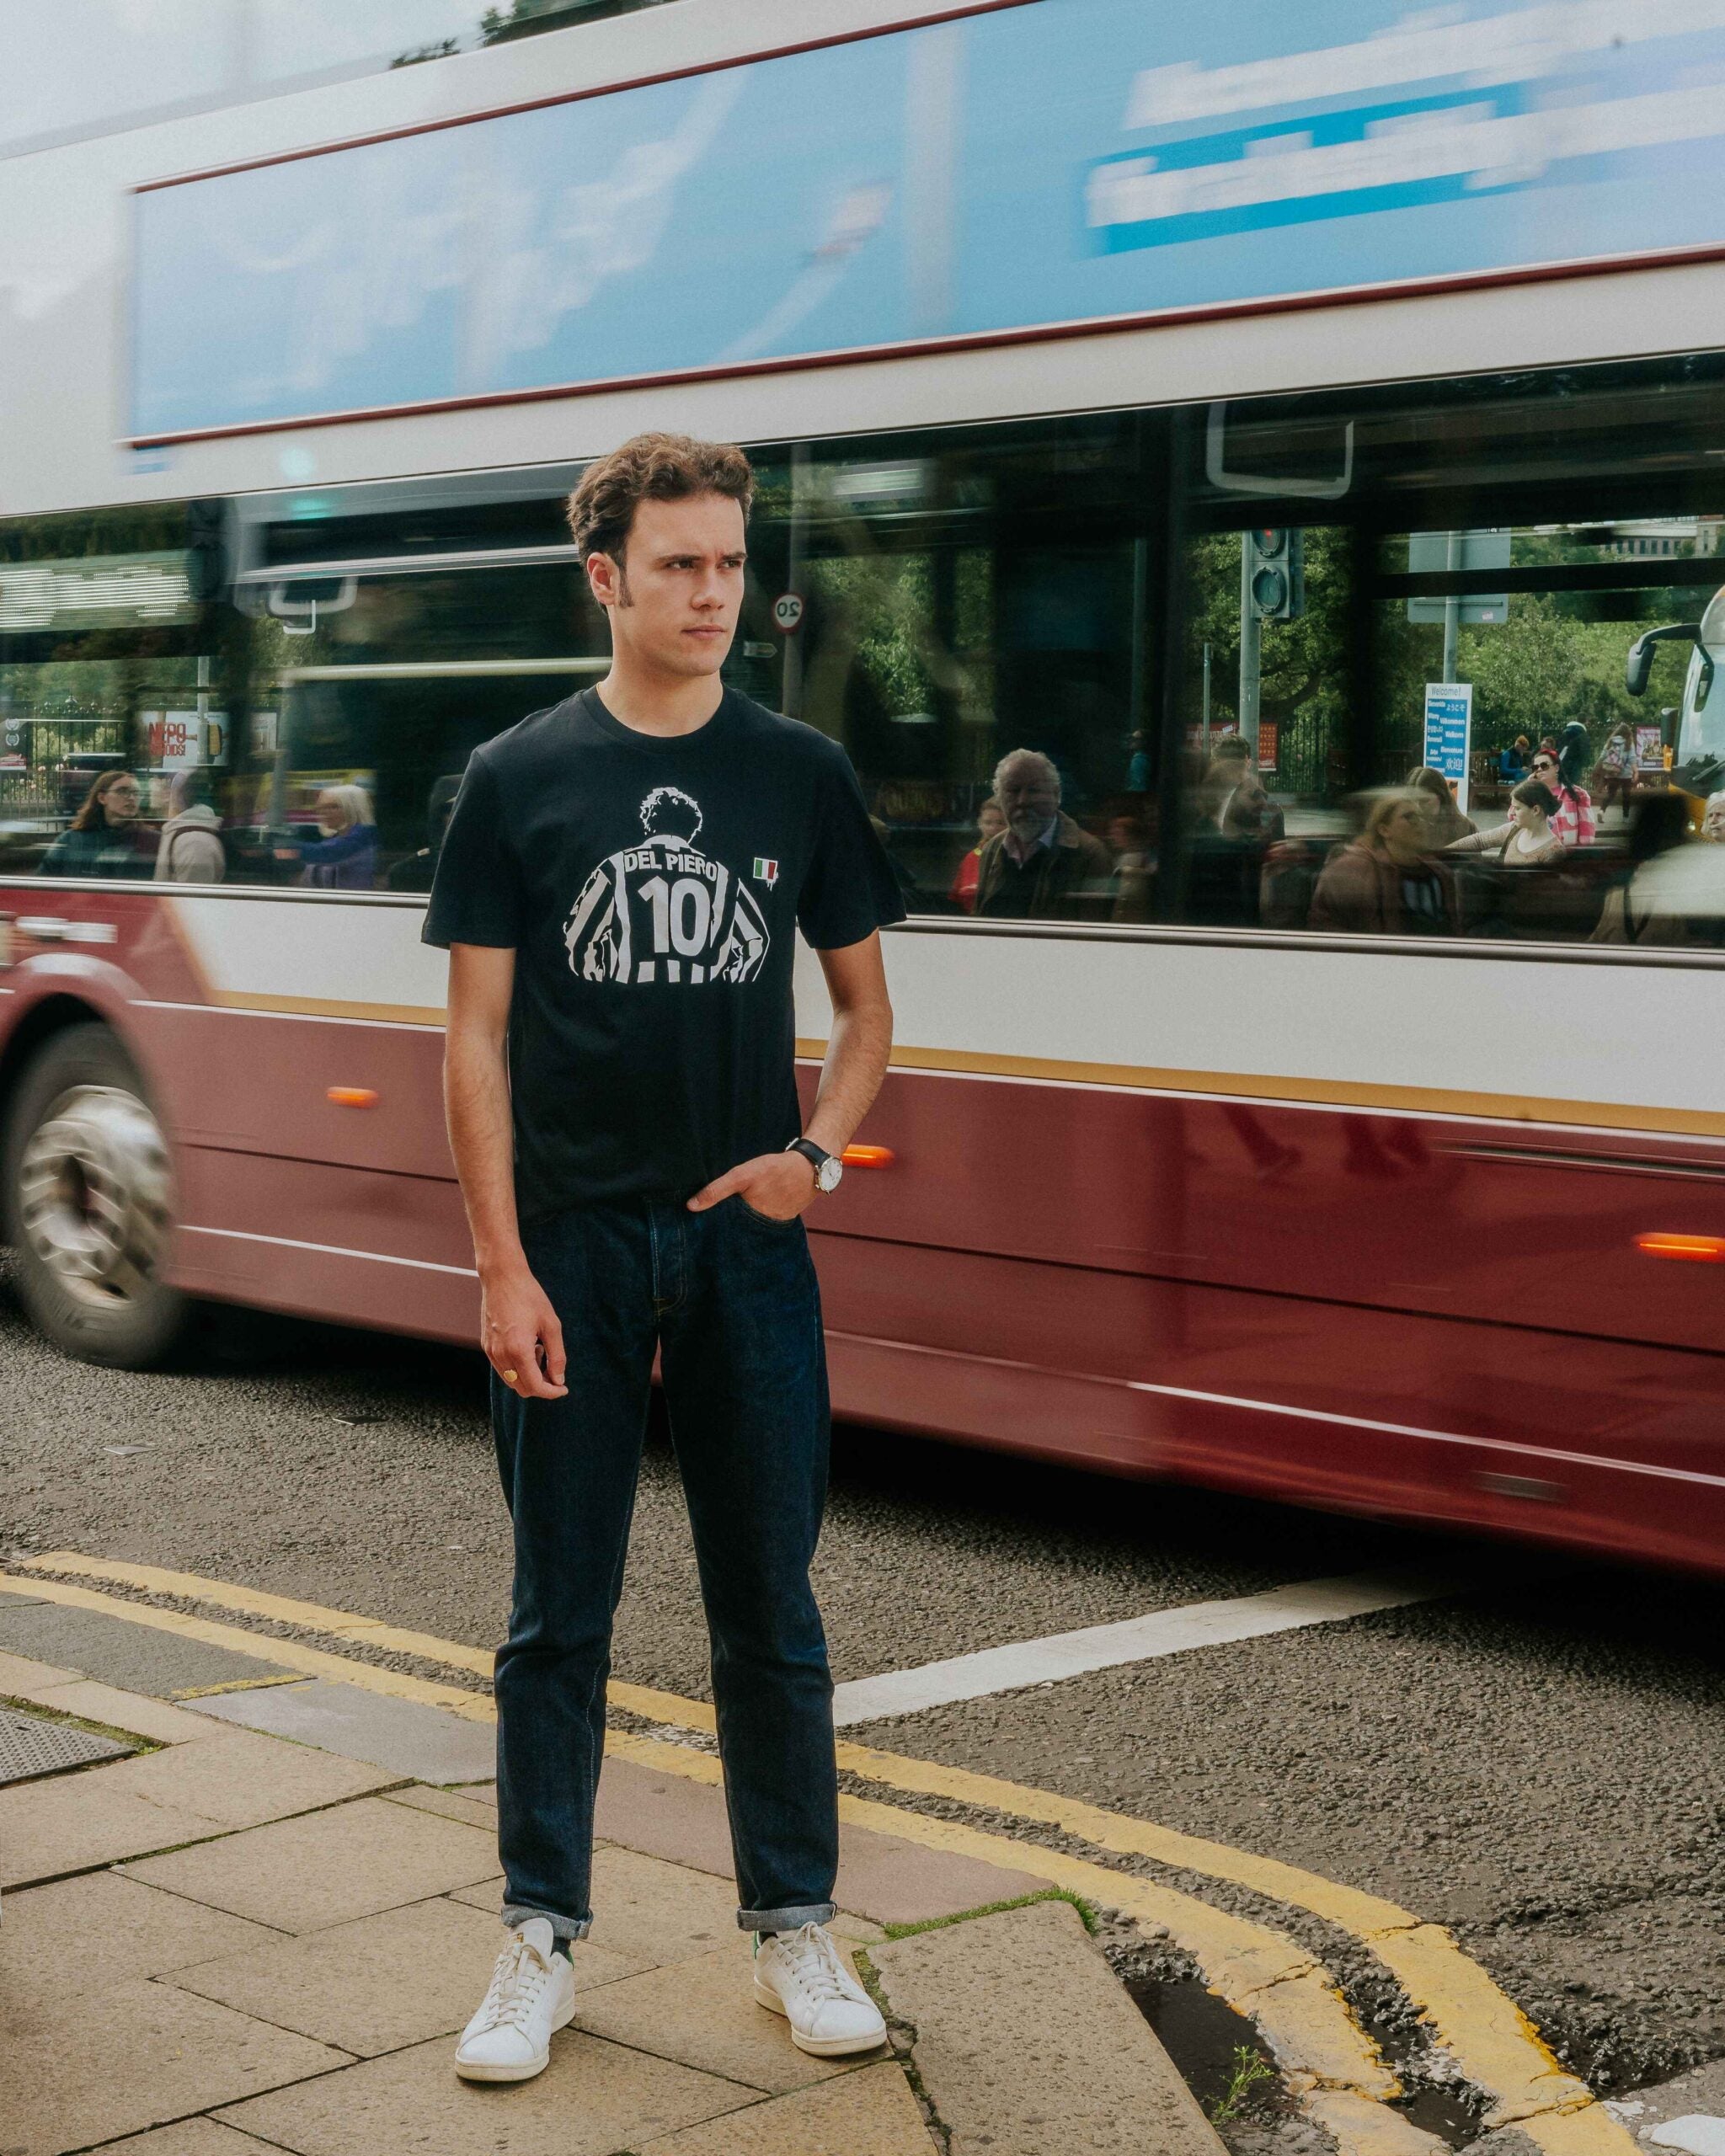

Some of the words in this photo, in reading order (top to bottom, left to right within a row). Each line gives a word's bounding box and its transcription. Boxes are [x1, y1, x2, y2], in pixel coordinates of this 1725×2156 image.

[1432, 686, 1461, 696] Welcome!
[623, 851, 662, 873] DEL
[666, 853, 717, 882] PIERO
[638, 875, 710, 957] 10
